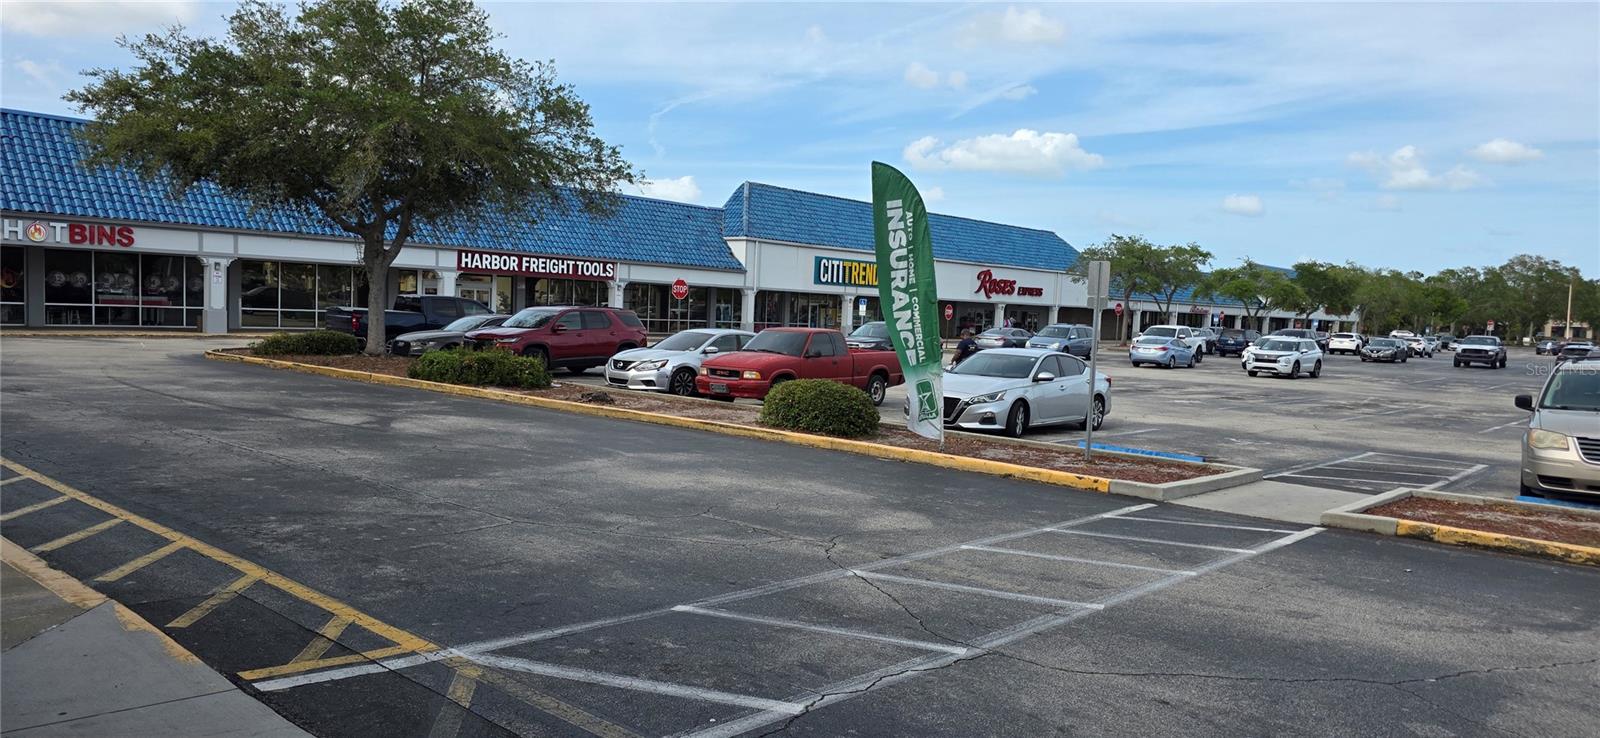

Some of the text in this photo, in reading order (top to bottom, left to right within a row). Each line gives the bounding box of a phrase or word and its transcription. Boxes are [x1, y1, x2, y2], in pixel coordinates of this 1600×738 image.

[461, 252, 614, 277] HARBOR FREIGHT TOOLS
[672, 285, 687, 293] STOP
[886, 199, 917, 367] INSURANCE
[905, 211, 927, 363] AUTO HOME COMMERCIAL
